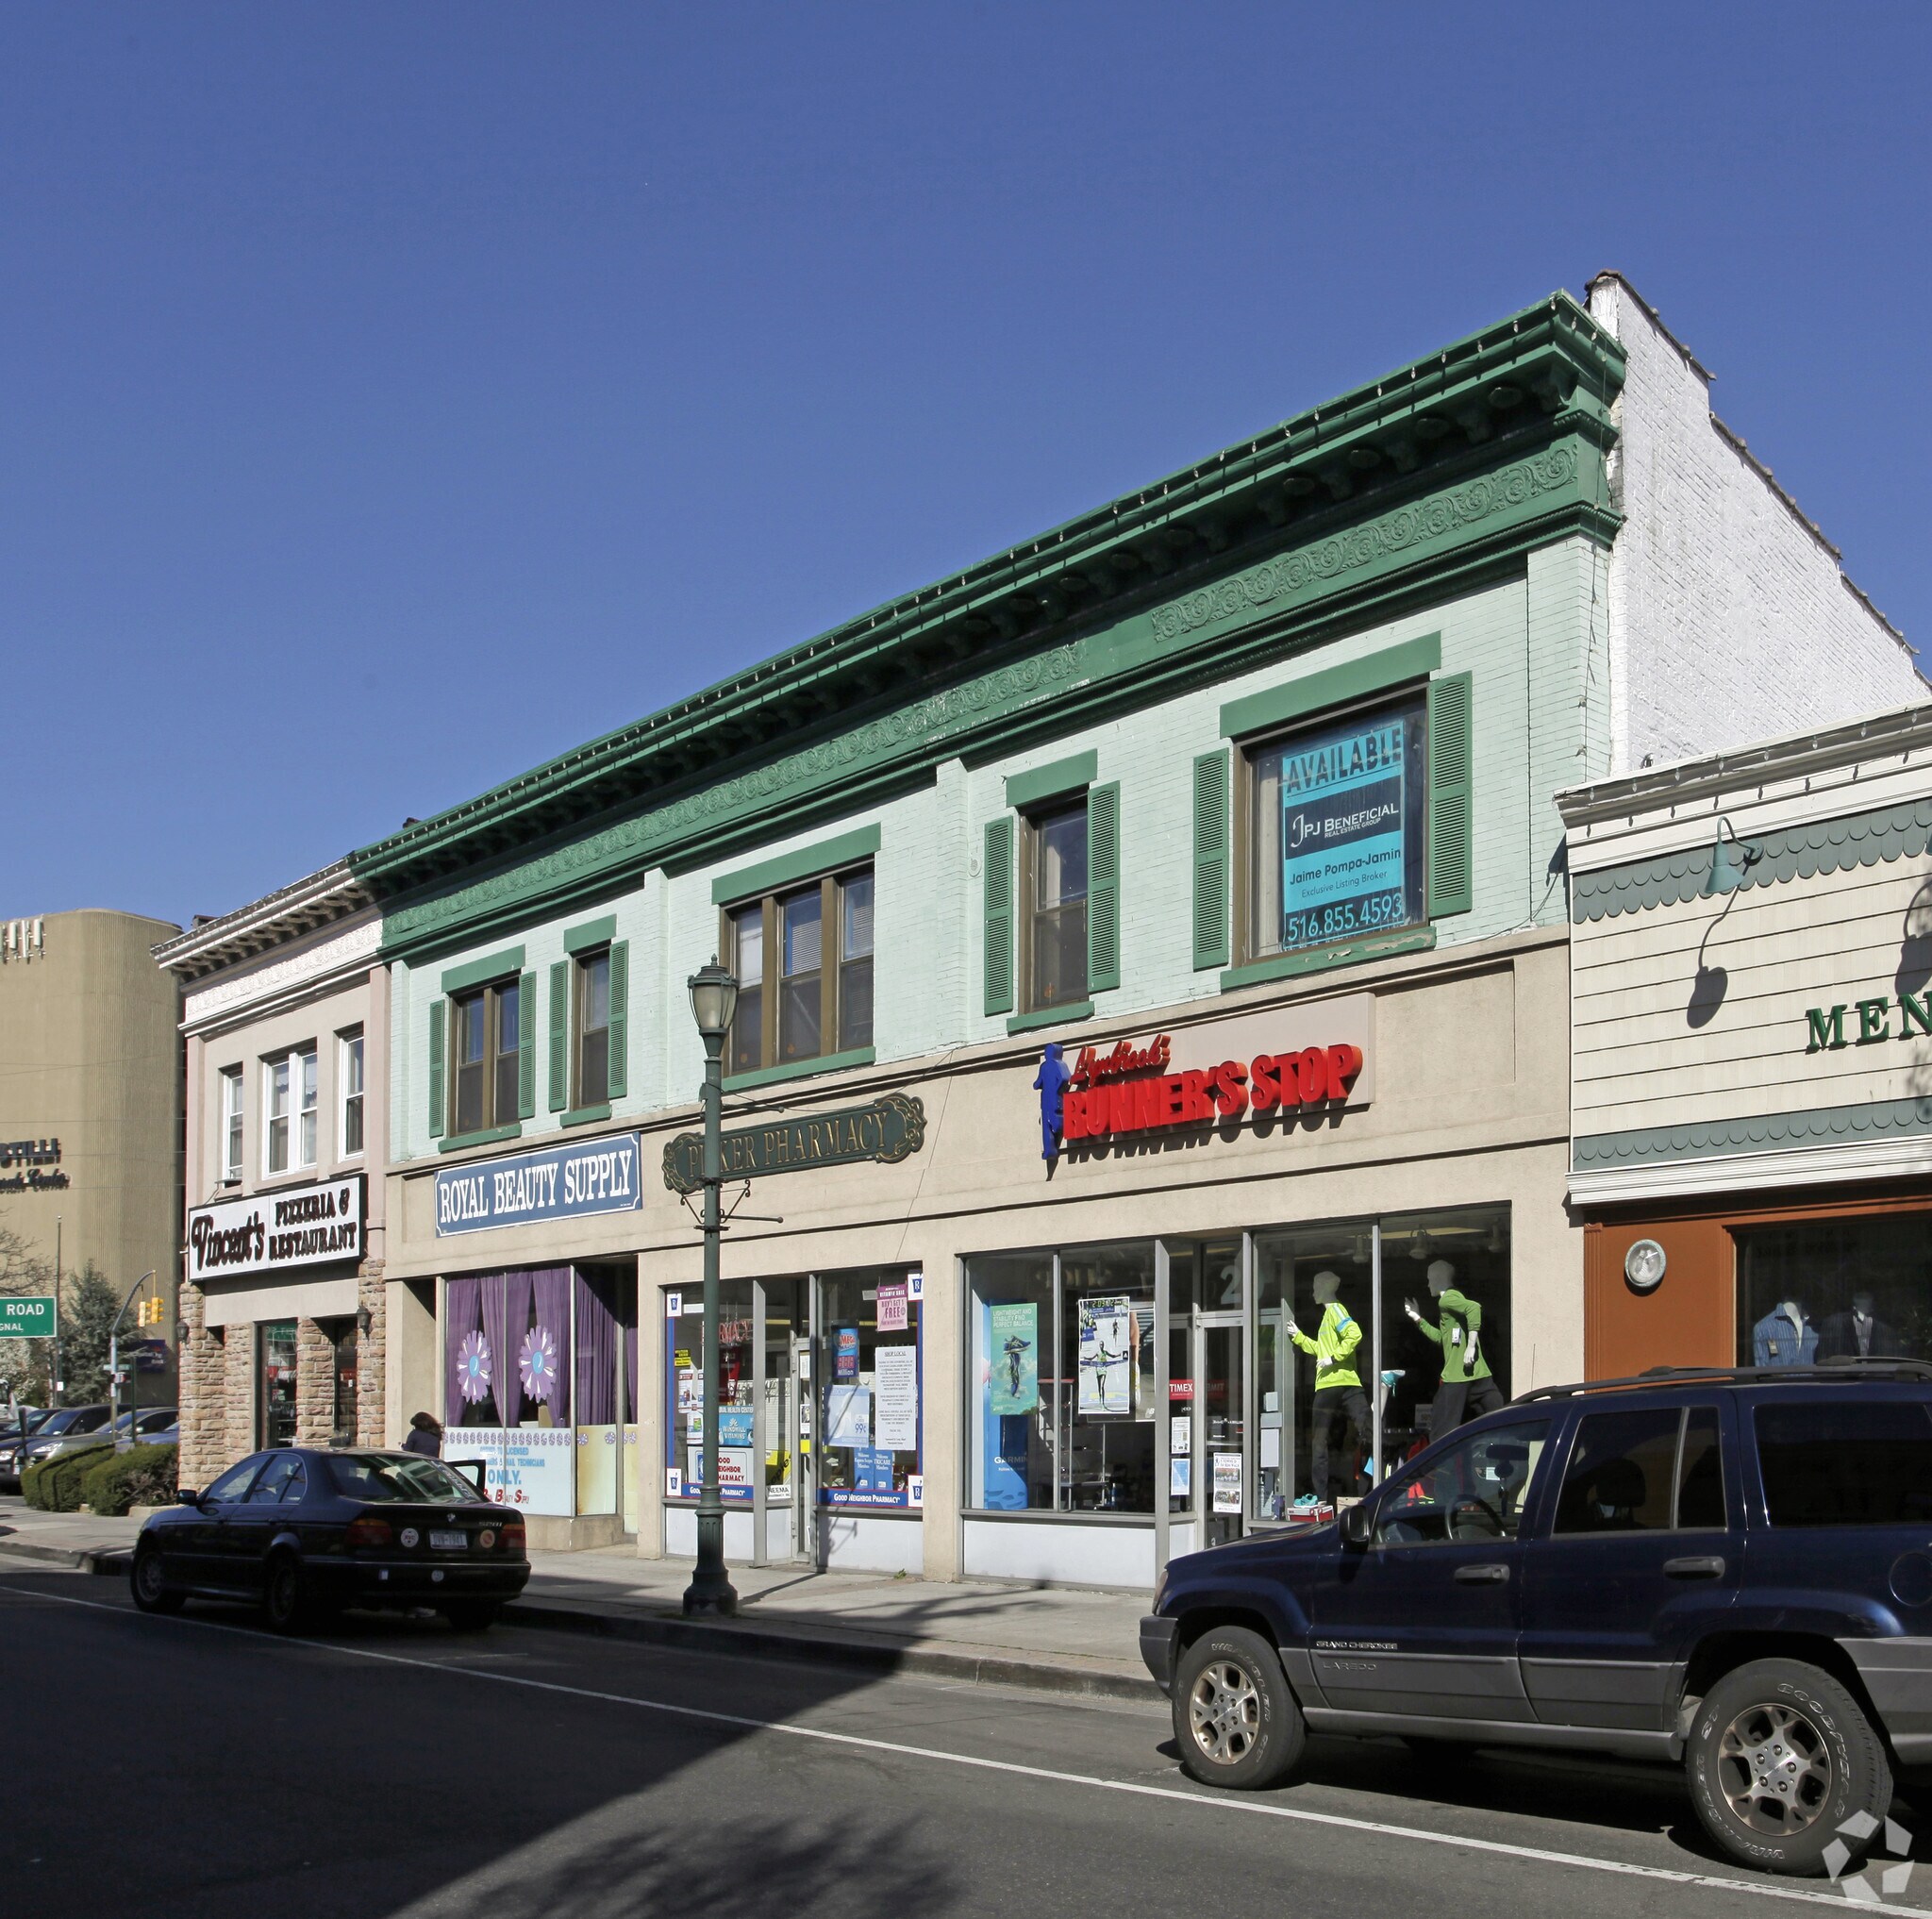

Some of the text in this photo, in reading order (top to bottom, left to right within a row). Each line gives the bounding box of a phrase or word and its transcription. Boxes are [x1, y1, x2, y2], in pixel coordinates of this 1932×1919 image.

[1286, 727, 1402, 794] AVAILABLE
[1291, 803, 1399, 848] JPJ BENEFICIAL
[1324, 817, 1382, 839] REAL ESTATE GROUP
[1290, 848, 1401, 886] Jaime Pompa-Jamin
[1301, 870, 1388, 898] Exclusive Listing Broker
[1288, 893, 1403, 942] 516.855.4593
[1063, 1043, 1363, 1140] RUNNER'S STOP
[688, 1110, 891, 1177] PIKER PHARMACY
[440, 1149, 633, 1224] ROYAL BEAUTY SUPPLY
[275, 1191, 336, 1227] PIZZERIA
[191, 1210, 265, 1271] Vincent's
[269, 1221, 357, 1260] RESTAURANT
[7, 1304, 45, 1316] ROAD
[885, 1307, 901, 1318] FREE
[1169, 1382, 1193, 1393] TIMEX
[718, 1465, 741, 1474] EIGHBOR
[849, 1493, 872, 1502] NEIGHBOR
[872, 1494, 900, 1503] PHARMACY
[1349, 1642, 1398, 1650] CHEROKEE
[1323, 1661, 1376, 1671] LAREDO
[1777, 1683, 1850, 1819] GOODYEAR
